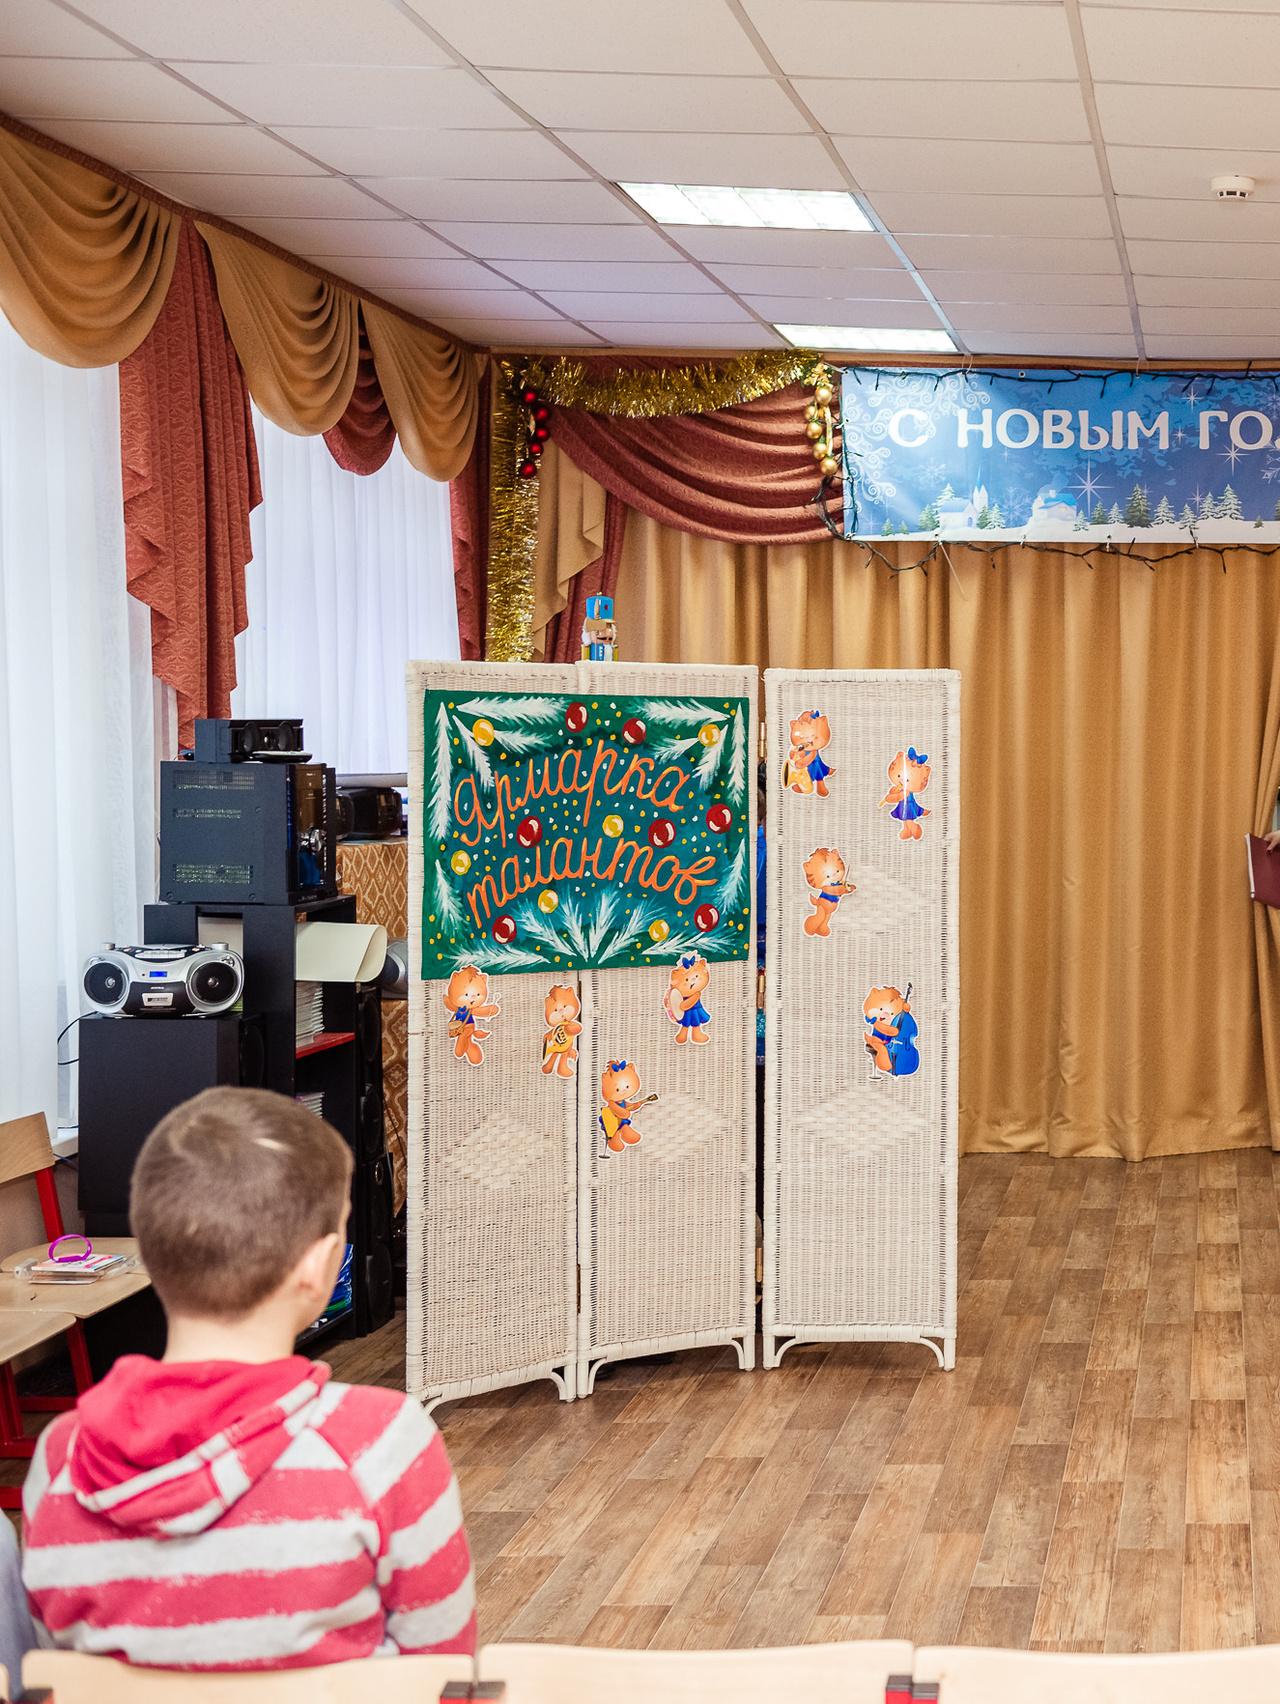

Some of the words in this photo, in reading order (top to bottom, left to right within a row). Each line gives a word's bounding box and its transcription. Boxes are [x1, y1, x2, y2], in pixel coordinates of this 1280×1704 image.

[888, 408, 929, 447] С
[957, 408, 1170, 450] НОВЫМ
[454, 739, 690, 848] Ярмарка
[467, 837, 718, 929] талантов
